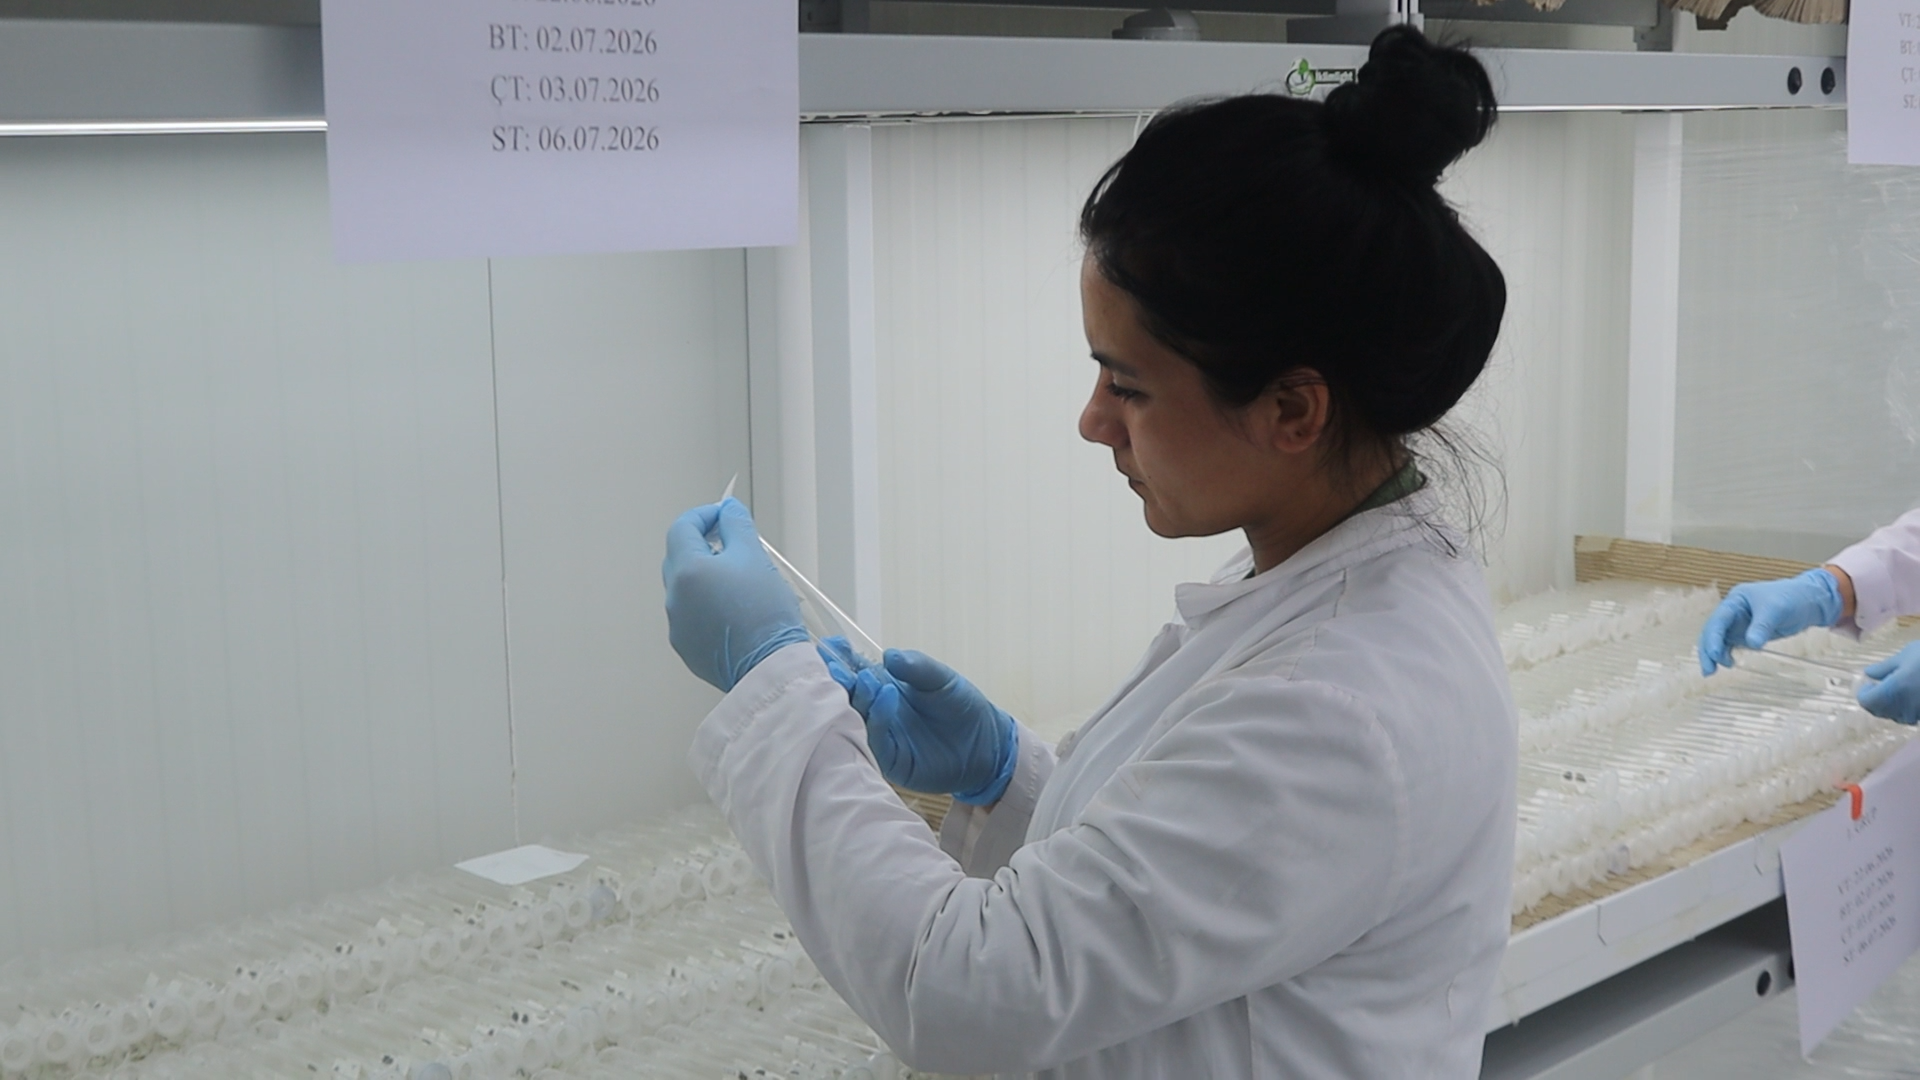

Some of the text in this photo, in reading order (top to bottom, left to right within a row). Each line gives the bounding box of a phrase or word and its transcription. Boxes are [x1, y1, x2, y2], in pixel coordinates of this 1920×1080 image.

[489, 24, 657, 54] BT: 02.07.2026
[490, 74, 660, 106] ÇT: 03.07.2026
[492, 125, 660, 151] ST: 06.07.2026
